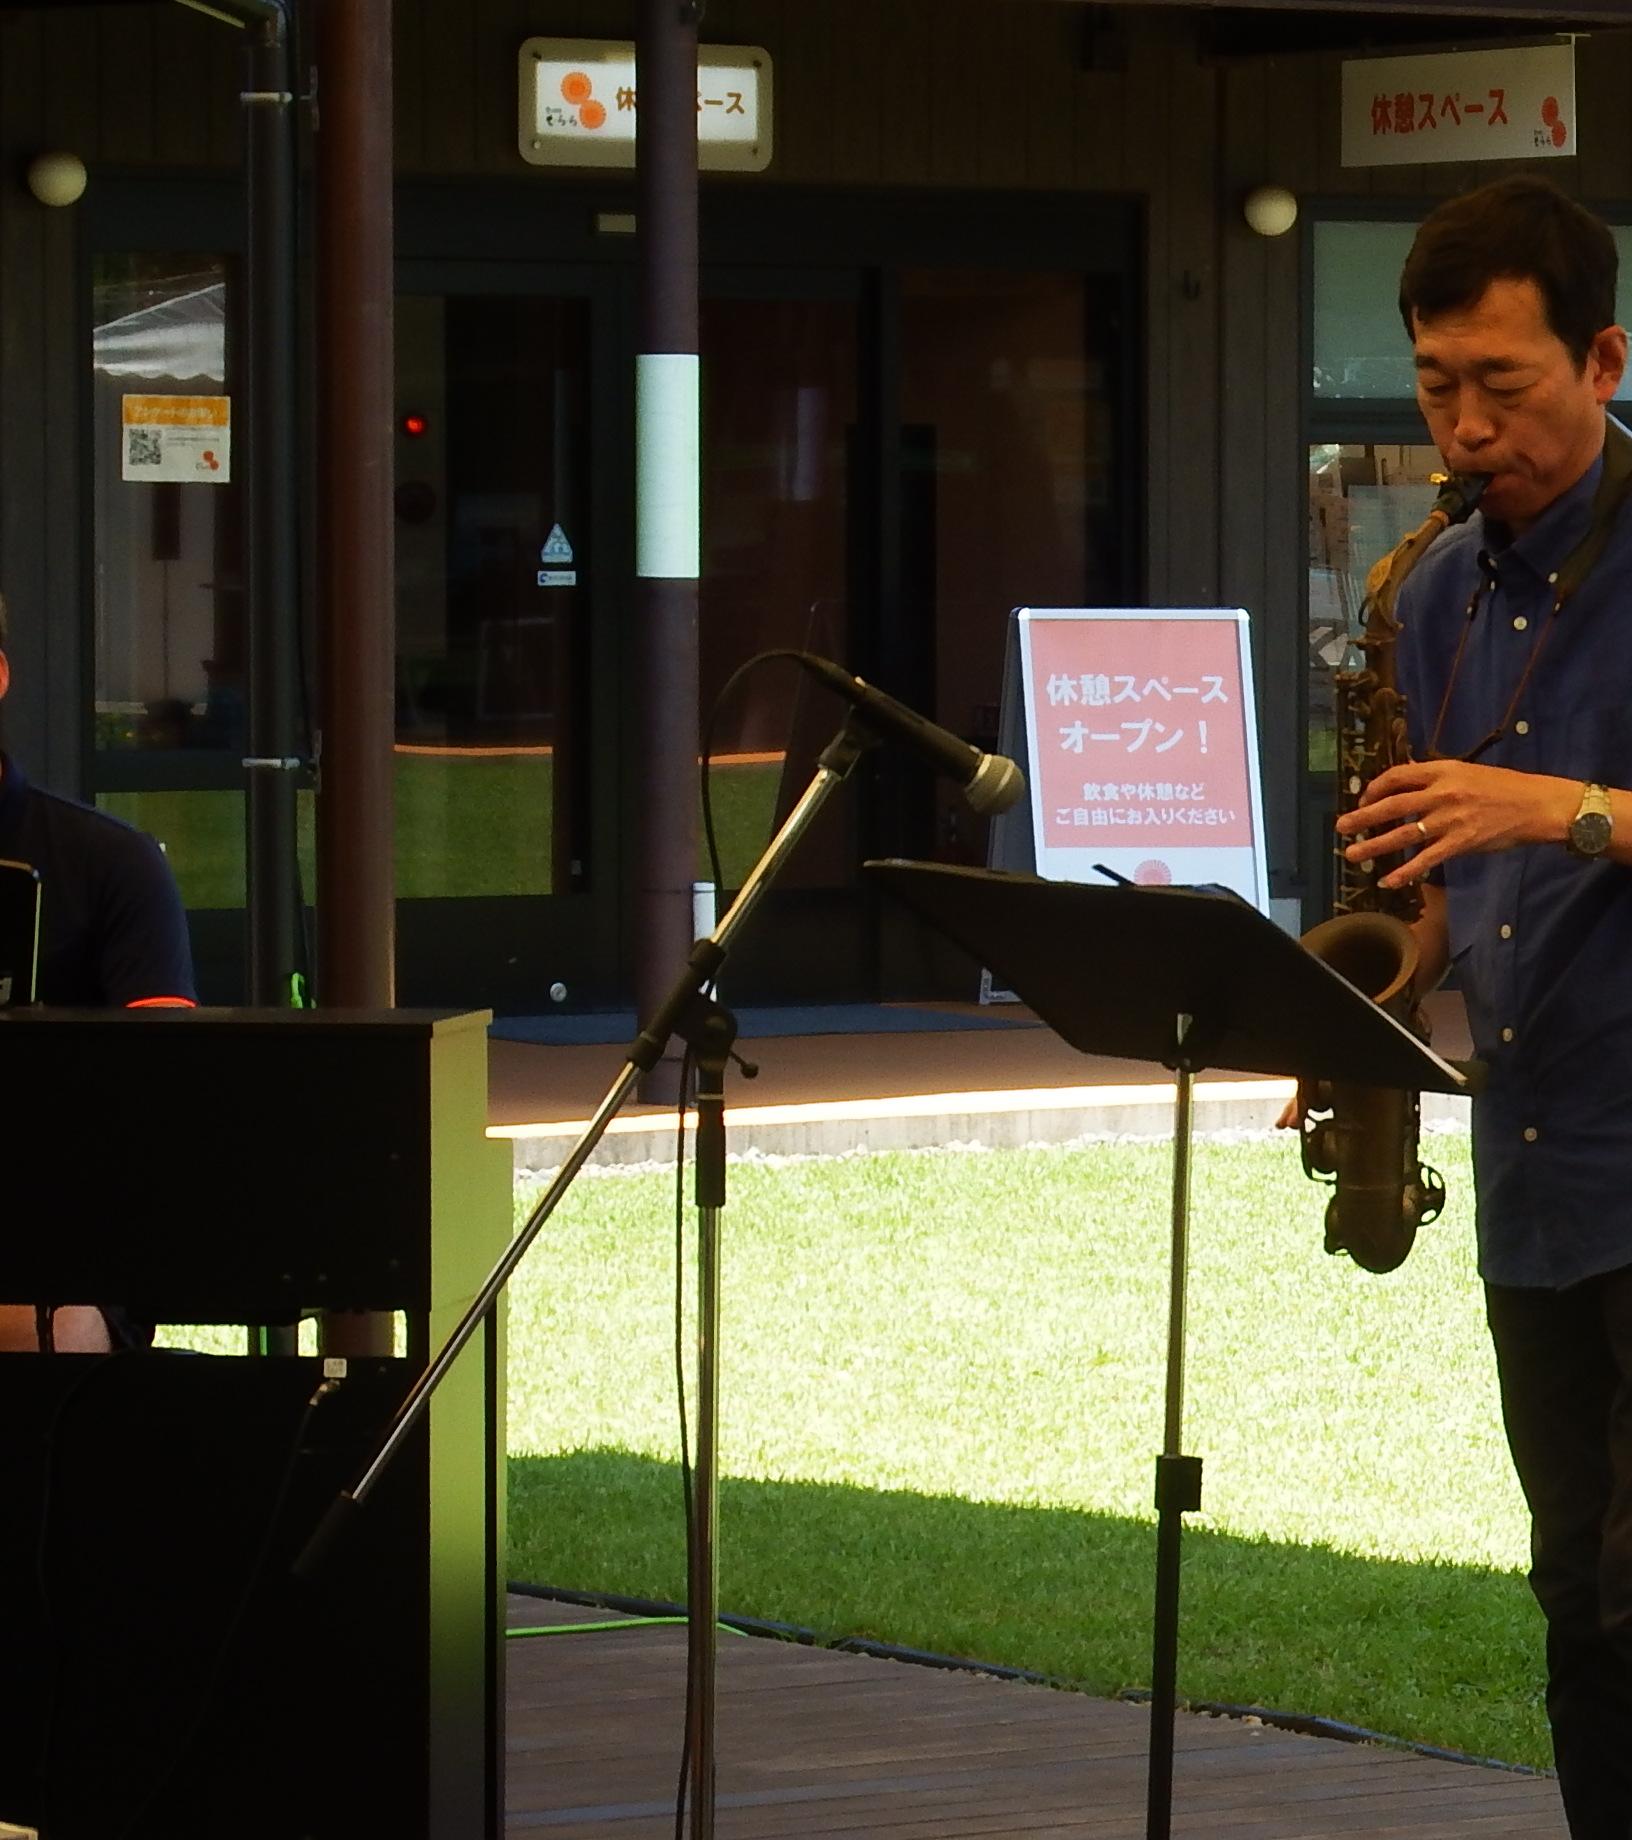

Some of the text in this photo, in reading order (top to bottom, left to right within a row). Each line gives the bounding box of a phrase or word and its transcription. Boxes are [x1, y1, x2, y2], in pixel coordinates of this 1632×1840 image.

[1371, 88, 1508, 135] 休憩スペース
[1046, 673, 1228, 706] 休憩スペース
[1059, 718, 1208, 754] オープン！
[1083, 782, 1205, 802] 飲食や休憩など
[1055, 807, 1236, 826] ご自由にお入りください
